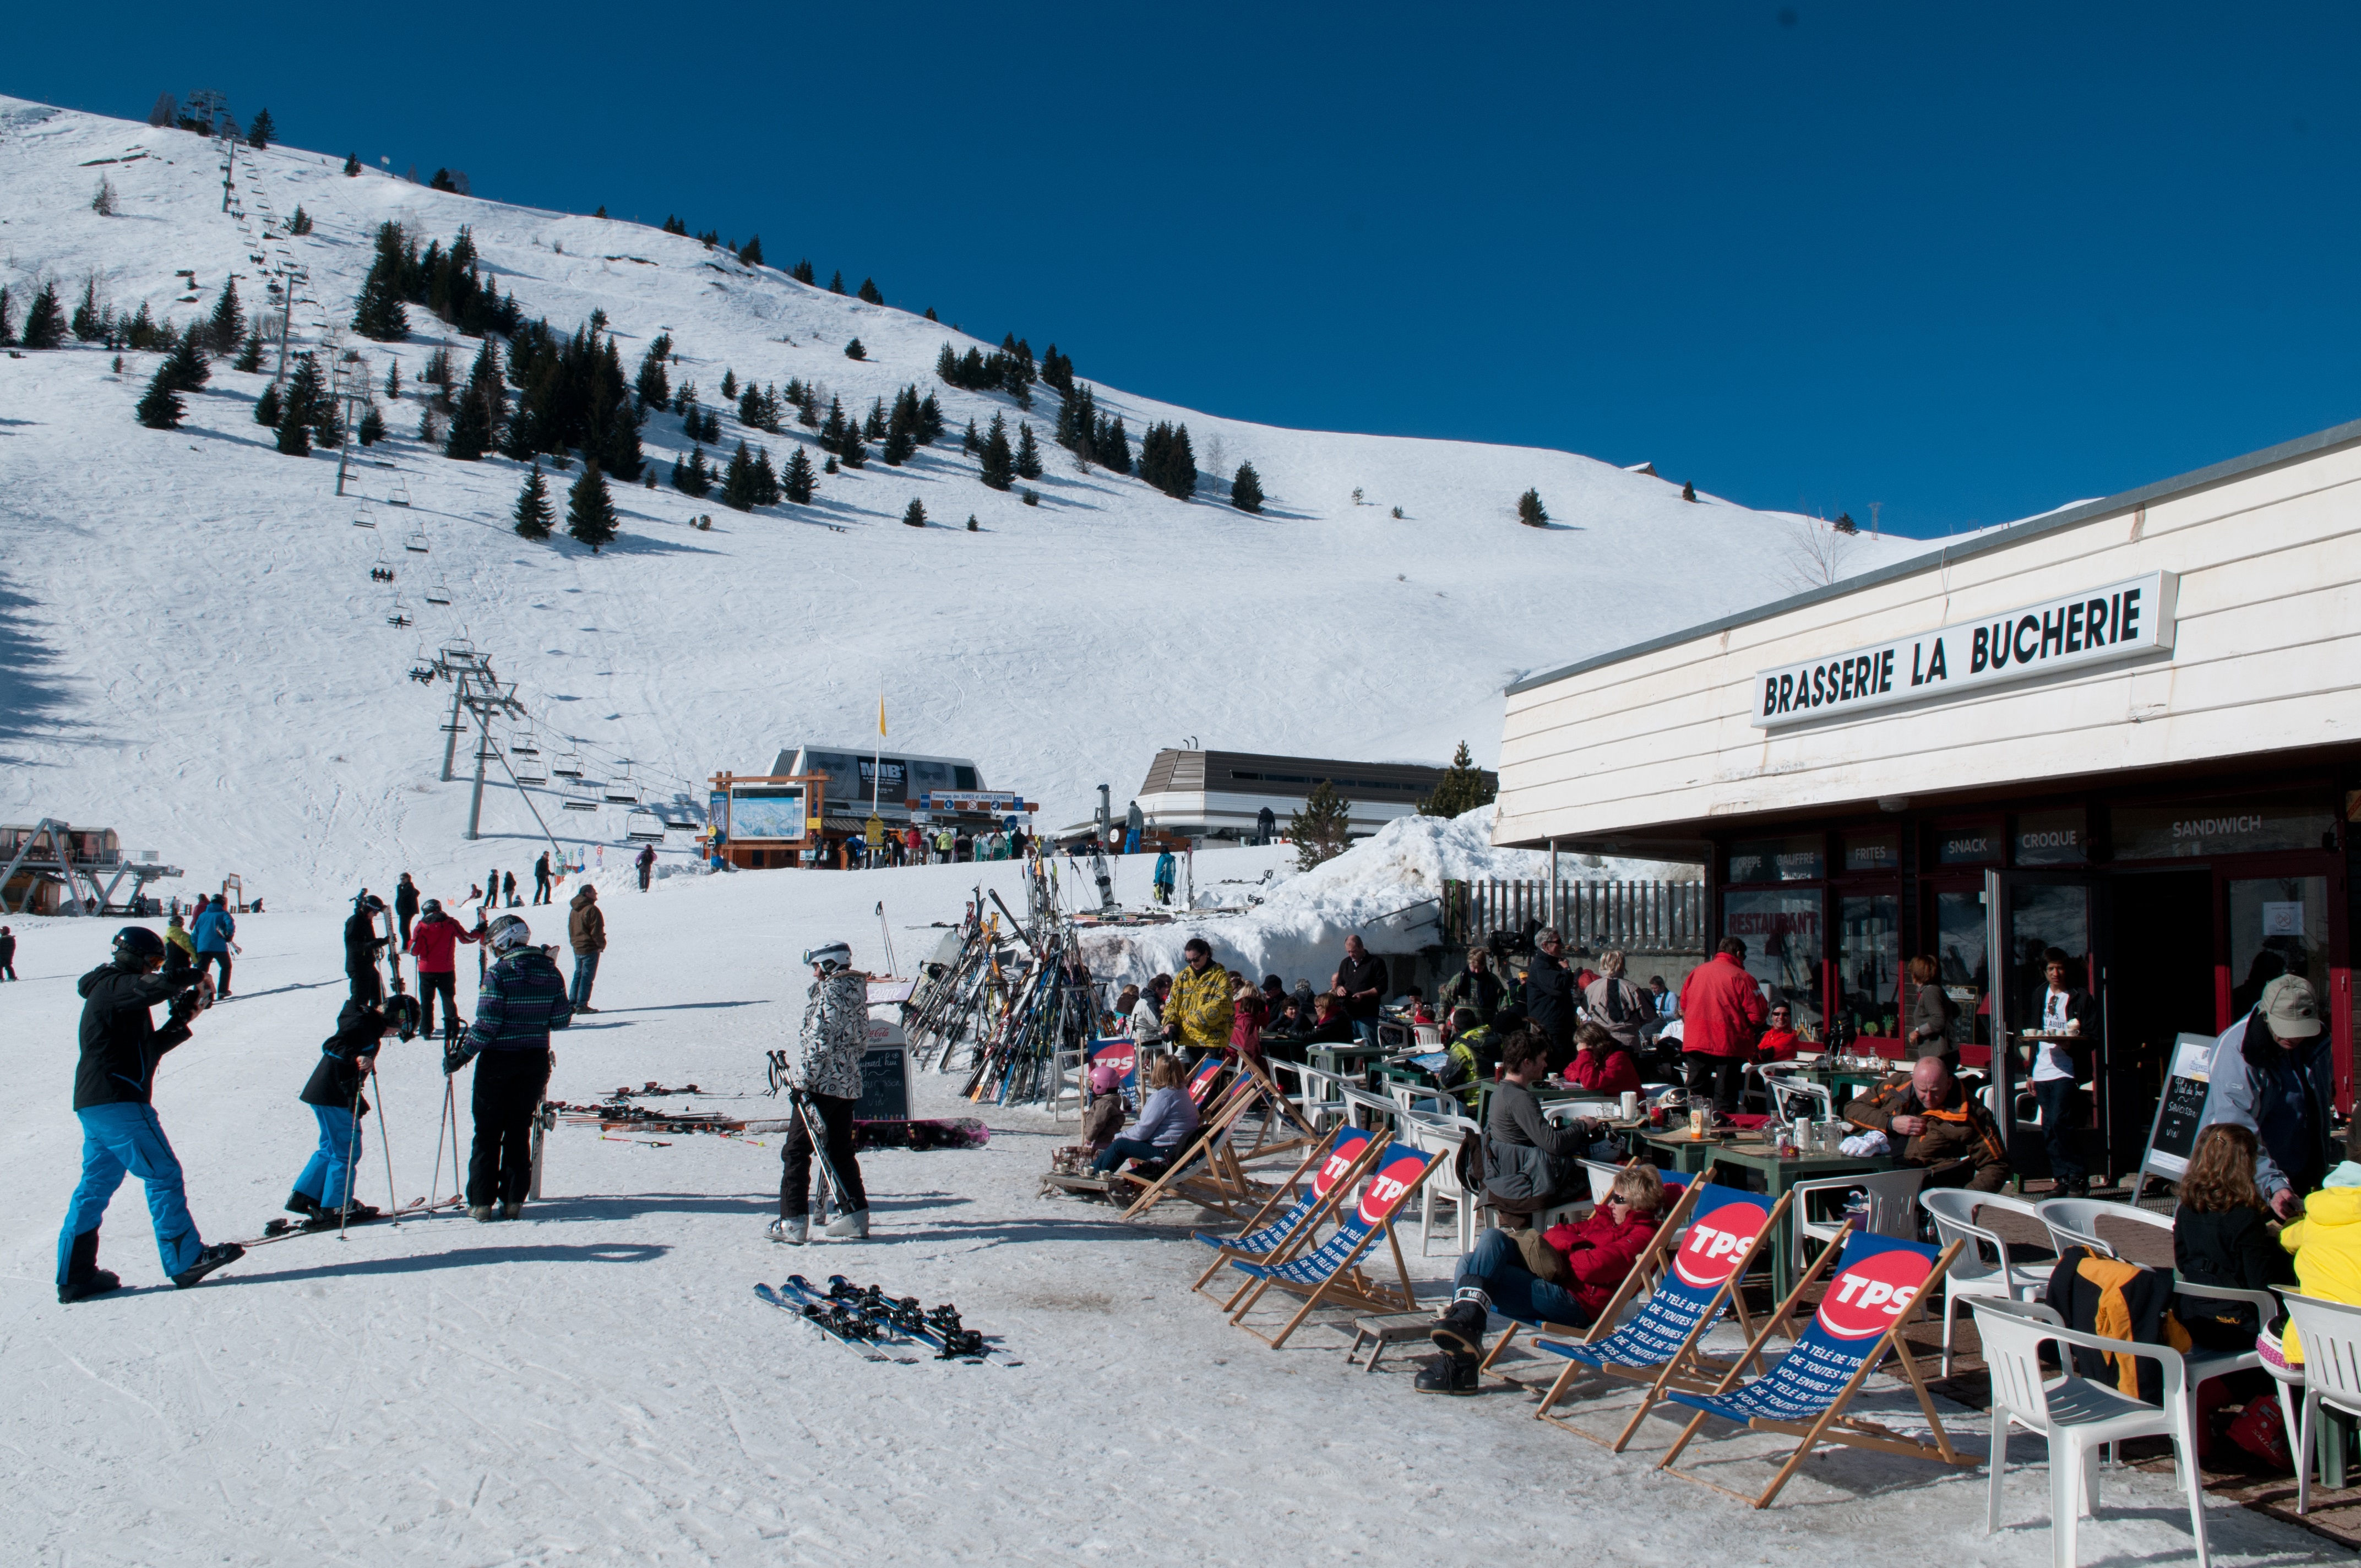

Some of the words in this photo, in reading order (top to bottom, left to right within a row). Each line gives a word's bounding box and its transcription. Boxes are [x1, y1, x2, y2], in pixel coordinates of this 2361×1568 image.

[1762, 649, 1895, 717] BRASSERIE
[1911, 636, 1948, 687] LA
[1970, 587, 2141, 674] BUCHERIE
[2172, 815, 2261, 837] SANDWICH
[1947, 838, 1988, 854] SNACK
[2022, 830, 2077, 848] CROQUE
[1776, 852, 1815, 866] GAUFFRE
[1855, 846, 1886, 861] FRITES
[1728, 911, 1819, 934] RESTAURANT
[1295, 1201, 1303, 1209] LA
[1288, 1211, 1296, 1220] DE
[1279, 1220, 1291, 1230] VOS
[1339, 1224, 1349, 1234] LA
[1332, 1236, 1343, 1245] DE
[1689, 1224, 1755, 1264] TPS
[1308, 1251, 1319, 1260] LA
[1323, 1245, 1335, 1256] VOS
[1287, 1264, 1300, 1275] VOS
[1299, 1259, 1312, 1268] DE
[1653, 1287, 1667, 1300] LA
[1666, 1293, 1689, 1308] TÉLÉ
[1684, 1302, 1699, 1312] DE
[1836, 1272, 1919, 1315] TPS
[1648, 1303, 1663, 1315] DE
[1661, 1309, 1692, 1326] TOUTES
[1638, 1315, 1657, 1329] VOS
[1653, 1324, 1683, 1340] ENVIES
[1622, 1323, 1636, 1335] LA
[1634, 1330, 1657, 1344] TÉLÉ
[1652, 1340, 1667, 1349] DE
[1584, 1343, 1597, 1352] LA
[1601, 1341, 1620, 1356] VOS
[1613, 1335, 1629, 1346] DE
[1626, 1342, 1658, 1360] TOUTES
[1794, 1338, 1809, 1351] LA
[1809, 1344, 1835, 1360] TÉLÉ
[1831, 1353, 1848, 1364] DE
[1787, 1354, 1806, 1366] DE
[1804, 1360, 1841, 1379] TOUTES
[1776, 1366, 1799, 1381] VOS
[1795, 1376, 1831, 1392] ENVIES
[1759, 1374, 1775, 1385] LA
[1772, 1381, 1800, 1397] TÉLÉ
[1794, 1392, 1813, 1402] DE
[1706, 1397, 1724, 1406] DE
[1718, 1393, 1733, 1402] LA
[1736, 1391, 1758, 1406] VOS
[1750, 1385, 1769, 1396] DE
[1765, 1393, 1802, 1411] TOUTES
